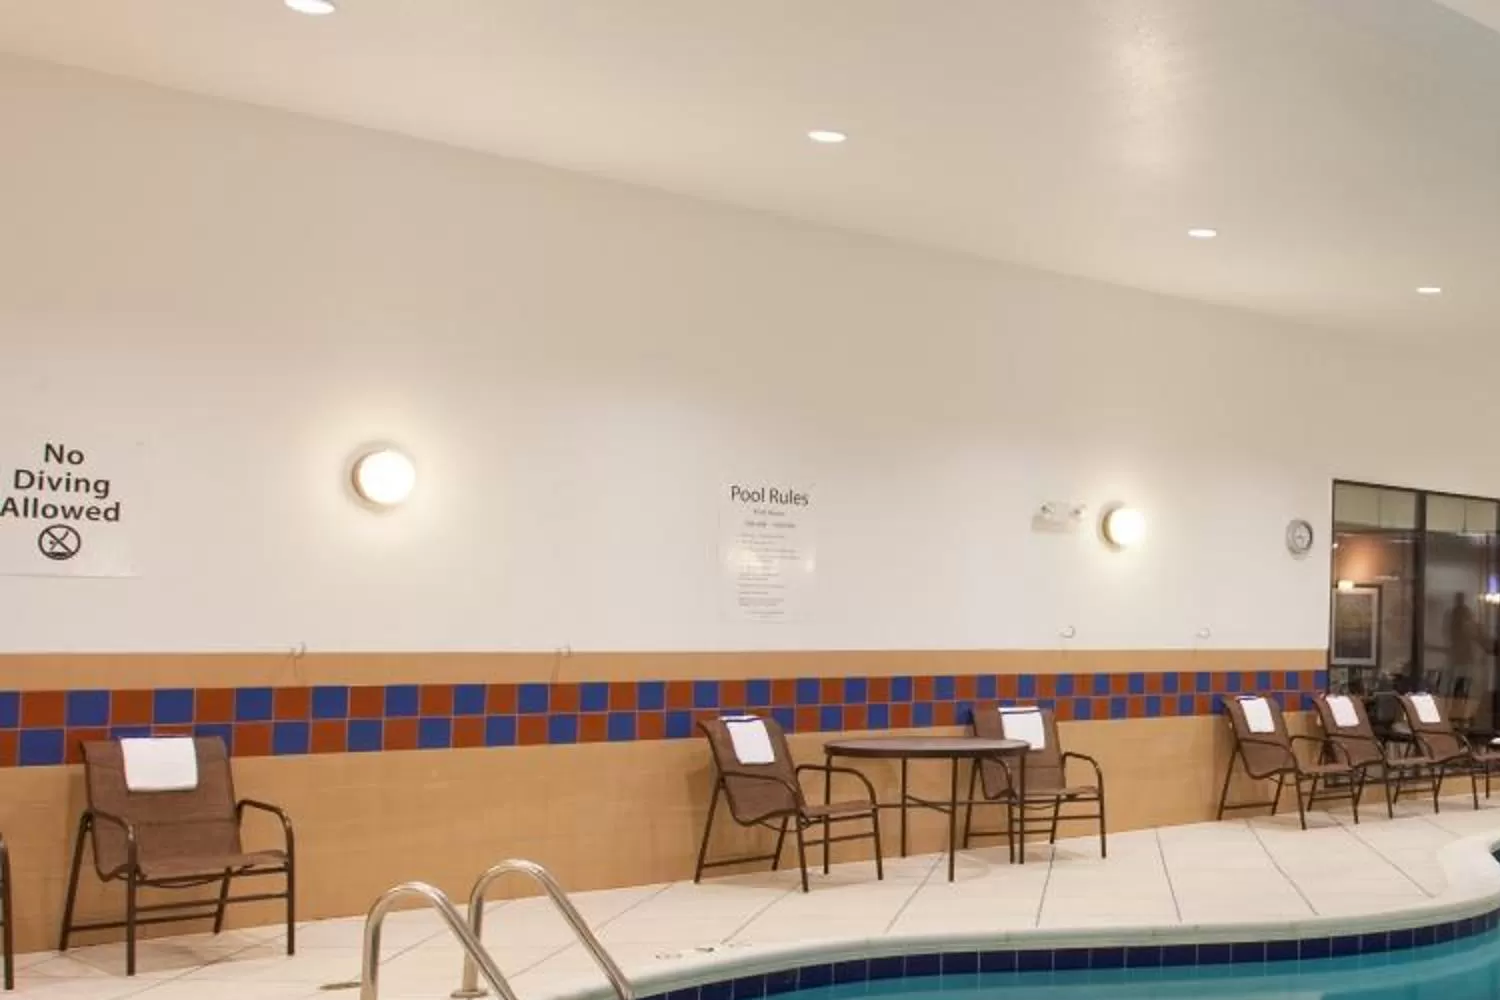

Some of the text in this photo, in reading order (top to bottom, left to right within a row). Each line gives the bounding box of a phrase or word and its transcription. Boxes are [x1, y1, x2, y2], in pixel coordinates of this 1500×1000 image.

[44, 443, 85, 465] No
[14, 469, 110, 499] Diving
[730, 485, 809, 505] Pool Rules
[0, 497, 120, 521] Allowed
